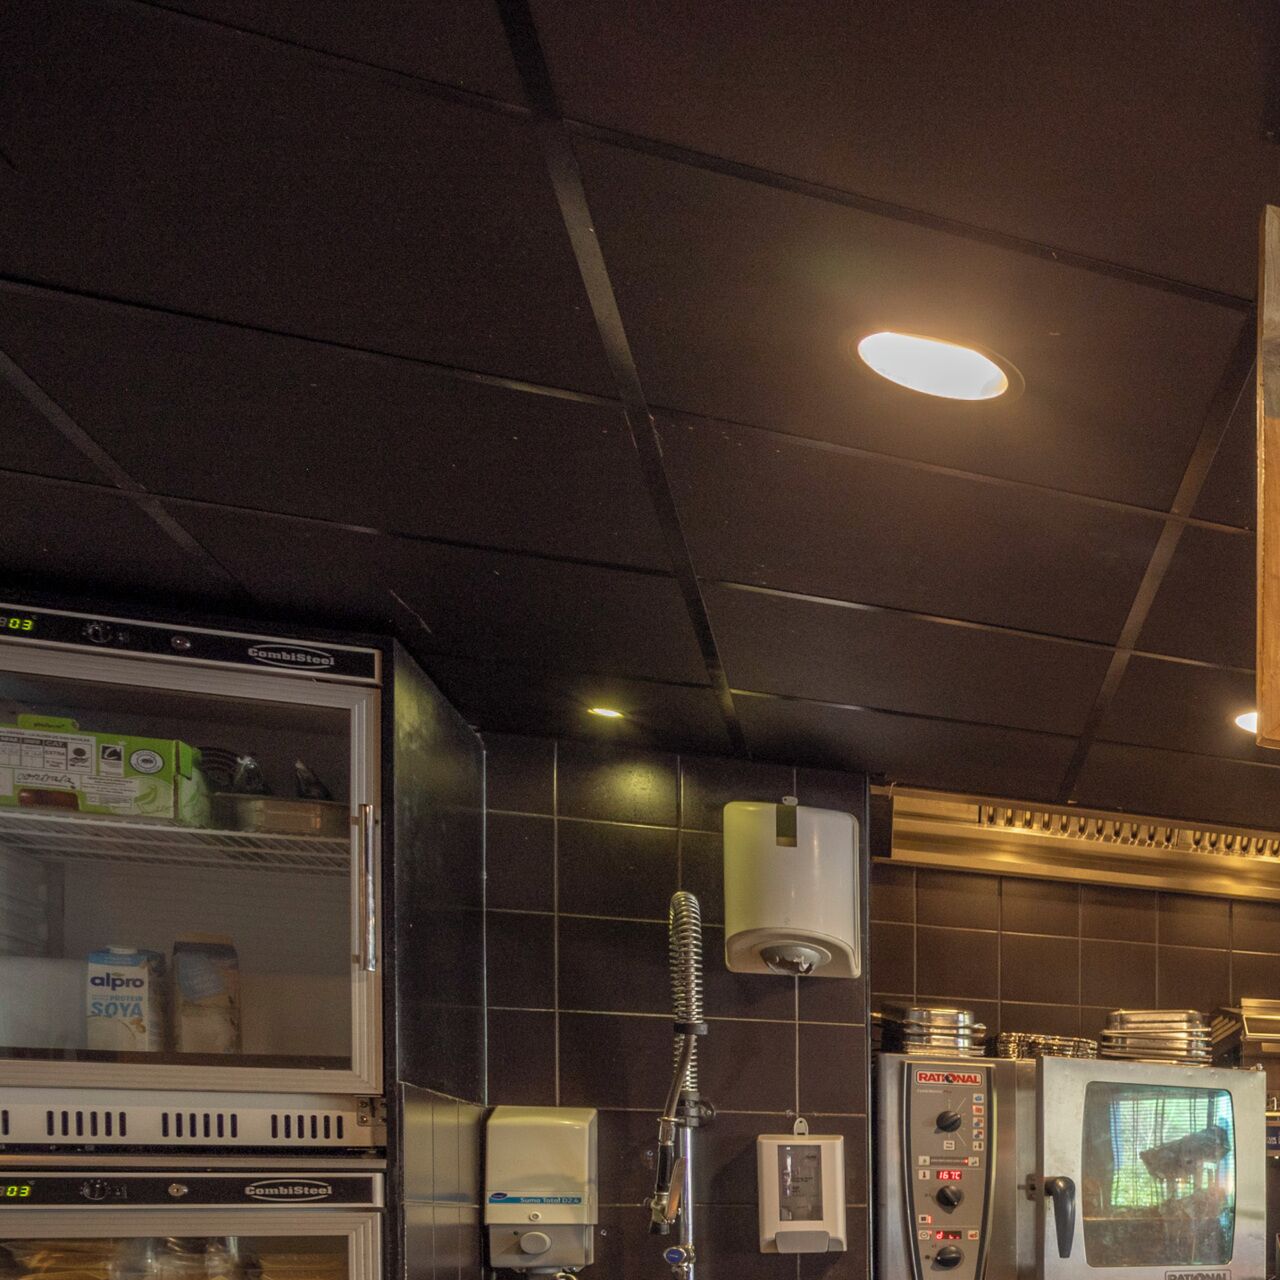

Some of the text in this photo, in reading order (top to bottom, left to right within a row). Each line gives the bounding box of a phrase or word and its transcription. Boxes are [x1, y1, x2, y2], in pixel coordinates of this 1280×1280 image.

[248, 649, 335, 667] CombiSteel
[90, 972, 144, 991] alpro
[91, 1002, 143, 1018] SOYA
[918, 1072, 980, 1084] RATIONAL
[6, 1186, 31, 1197] 03
[245, 1186, 332, 1196] CombiSteel
